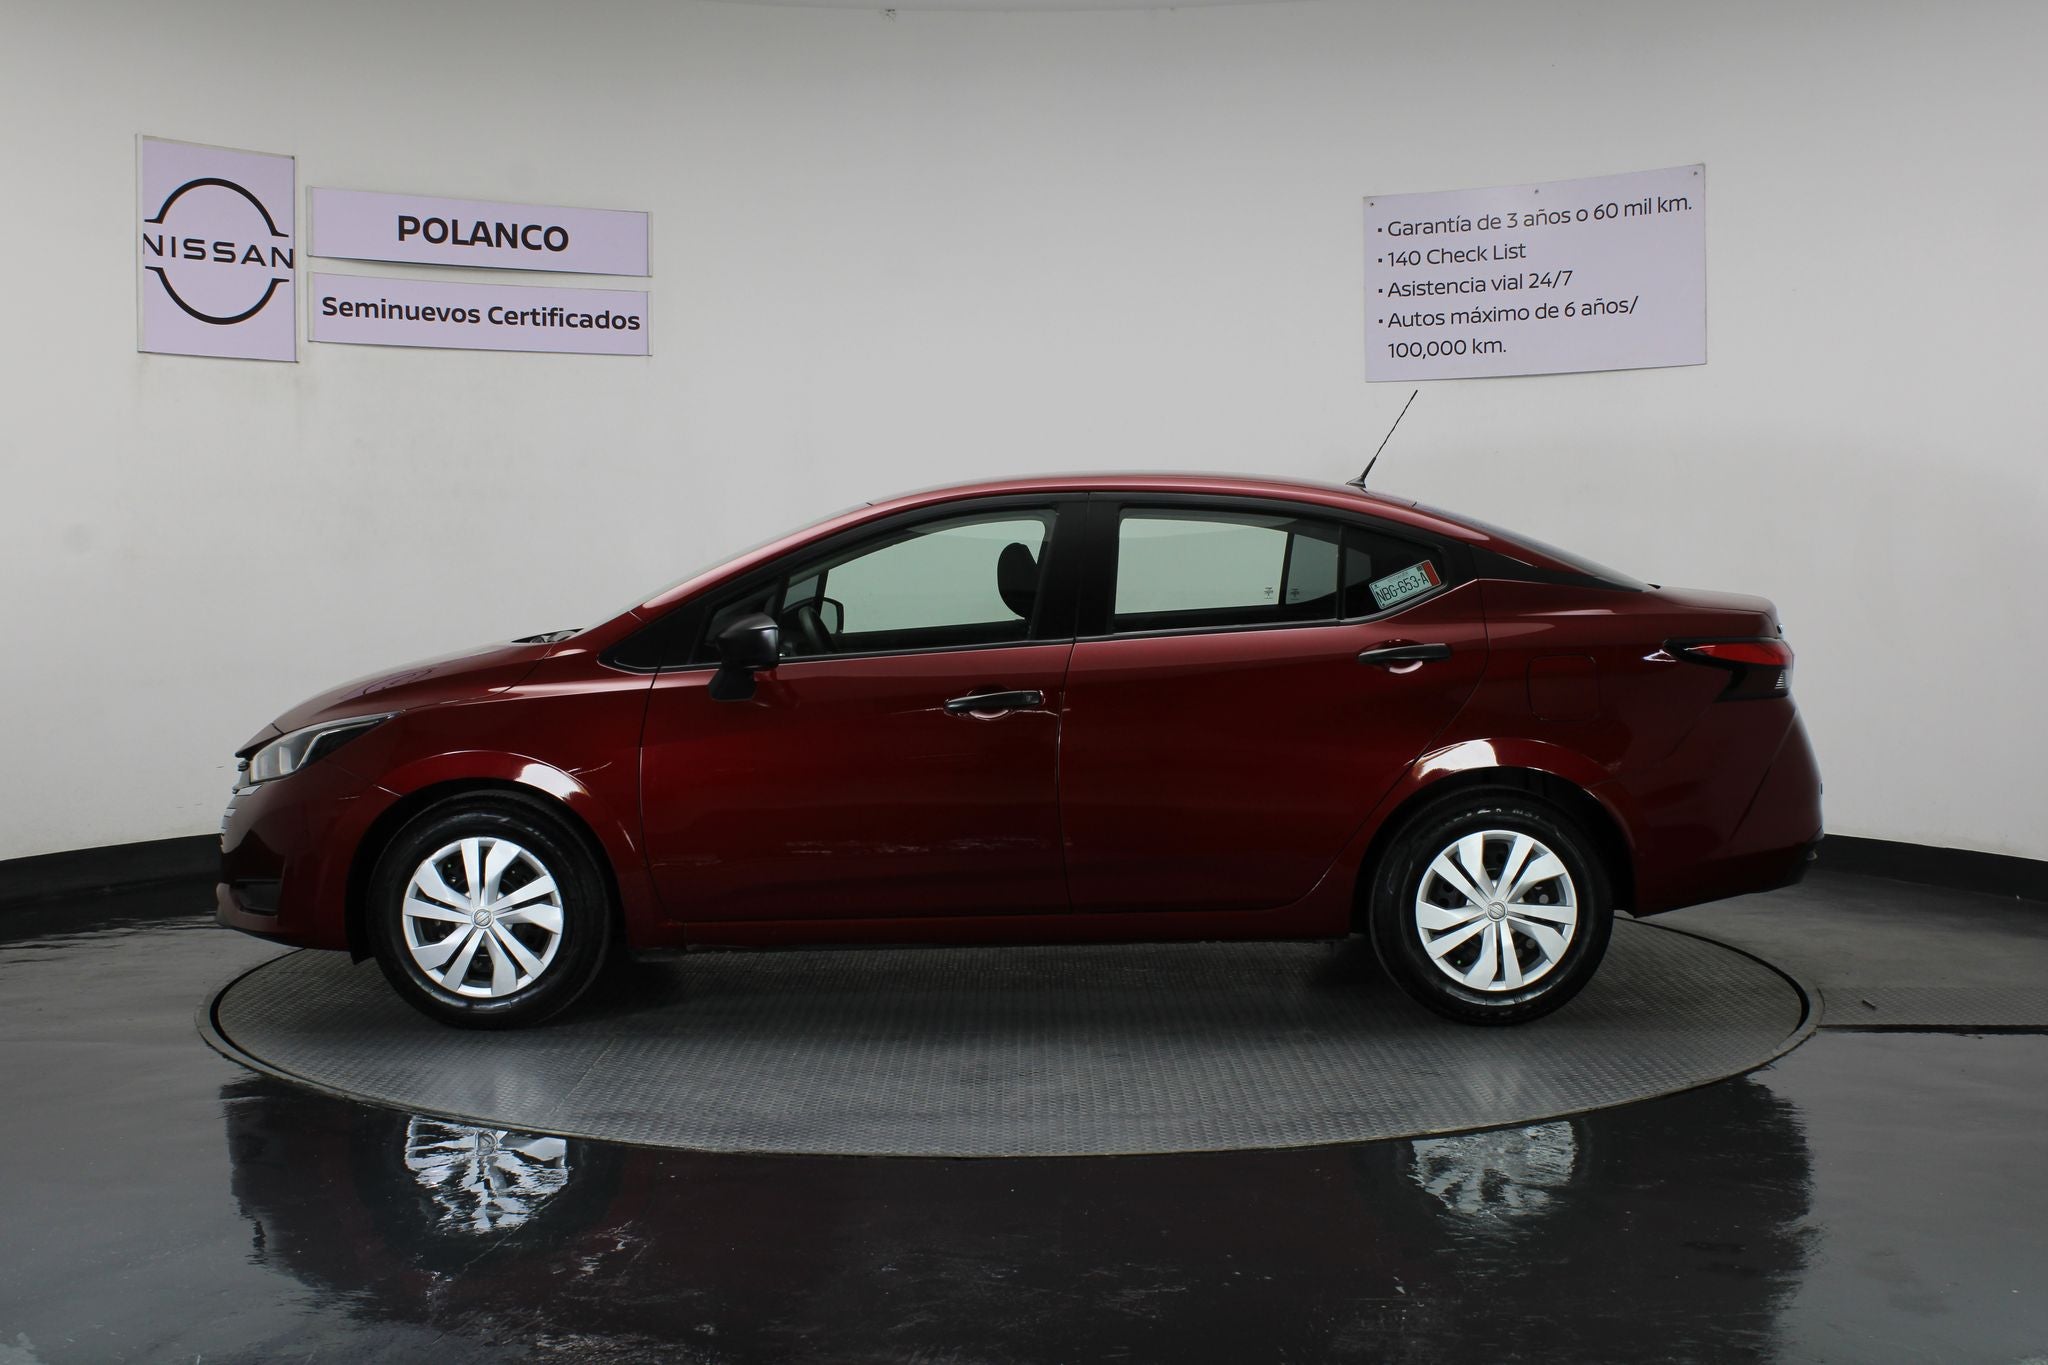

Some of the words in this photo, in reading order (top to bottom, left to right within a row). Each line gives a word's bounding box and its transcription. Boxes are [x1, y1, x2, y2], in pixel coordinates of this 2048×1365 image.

[399, 215, 569, 252] POLANCO
[1387, 215, 1472, 237] Garantía
[1477, 214, 1502, 231] de
[1506, 212, 1518, 229] 3
[1523, 208, 1571, 227] años
[1575, 208, 1589, 222] o
[1593, 202, 1619, 221] 60
[1624, 197, 1652, 217] mil
[1657, 196, 1692, 214] km.
[142, 232, 294, 270] NISSAN
[1387, 251, 1422, 268] 140
[1426, 245, 1488, 266] Check
[1493, 243, 1527, 261] List
[1387, 276, 1487, 298] Asistencia
[1490, 273, 1523, 292] vial
[1528, 269, 1574, 290] 24/7
[322, 296, 481, 324] Seminuevos
[487, 306, 641, 331] Certificados
[1387, 311, 1446, 329] Autos
[1450, 305, 1530, 326] máximo
[1534, 302, 1560, 320] de
[1564, 301, 1577, 318] 6
[1581, 295, 1639, 317] años/
[1387, 339, 1467, 360] 100,000
[1471, 337, 1507, 355] km.
[1374, 571, 1430, 604] NBG-653-A
